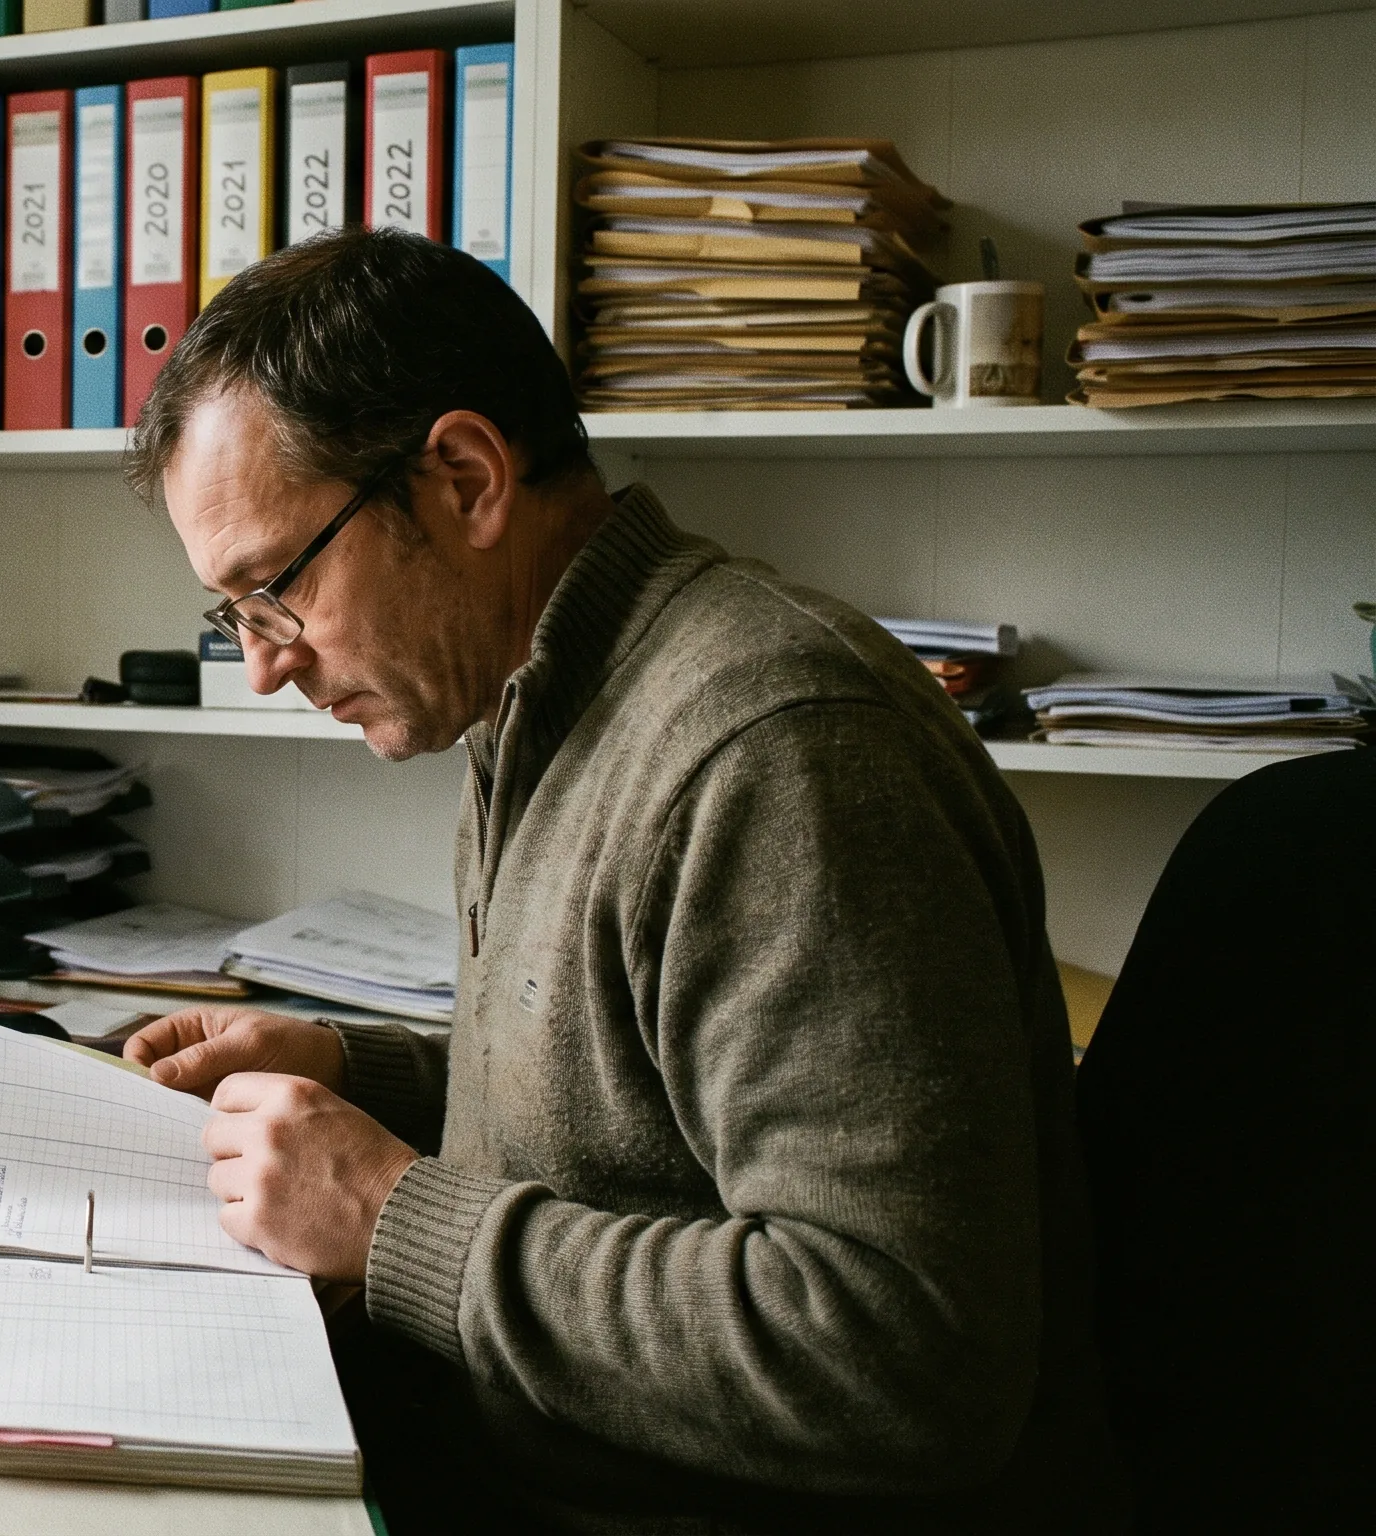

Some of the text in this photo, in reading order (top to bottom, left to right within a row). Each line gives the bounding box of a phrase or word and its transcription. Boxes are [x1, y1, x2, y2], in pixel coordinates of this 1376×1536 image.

[23, 183, 45, 246] 2021
[145, 163, 169, 237] 2020
[221, 160, 246, 231] 2021
[304, 149, 329, 228] 2022
[385, 139, 412, 220] 2022
